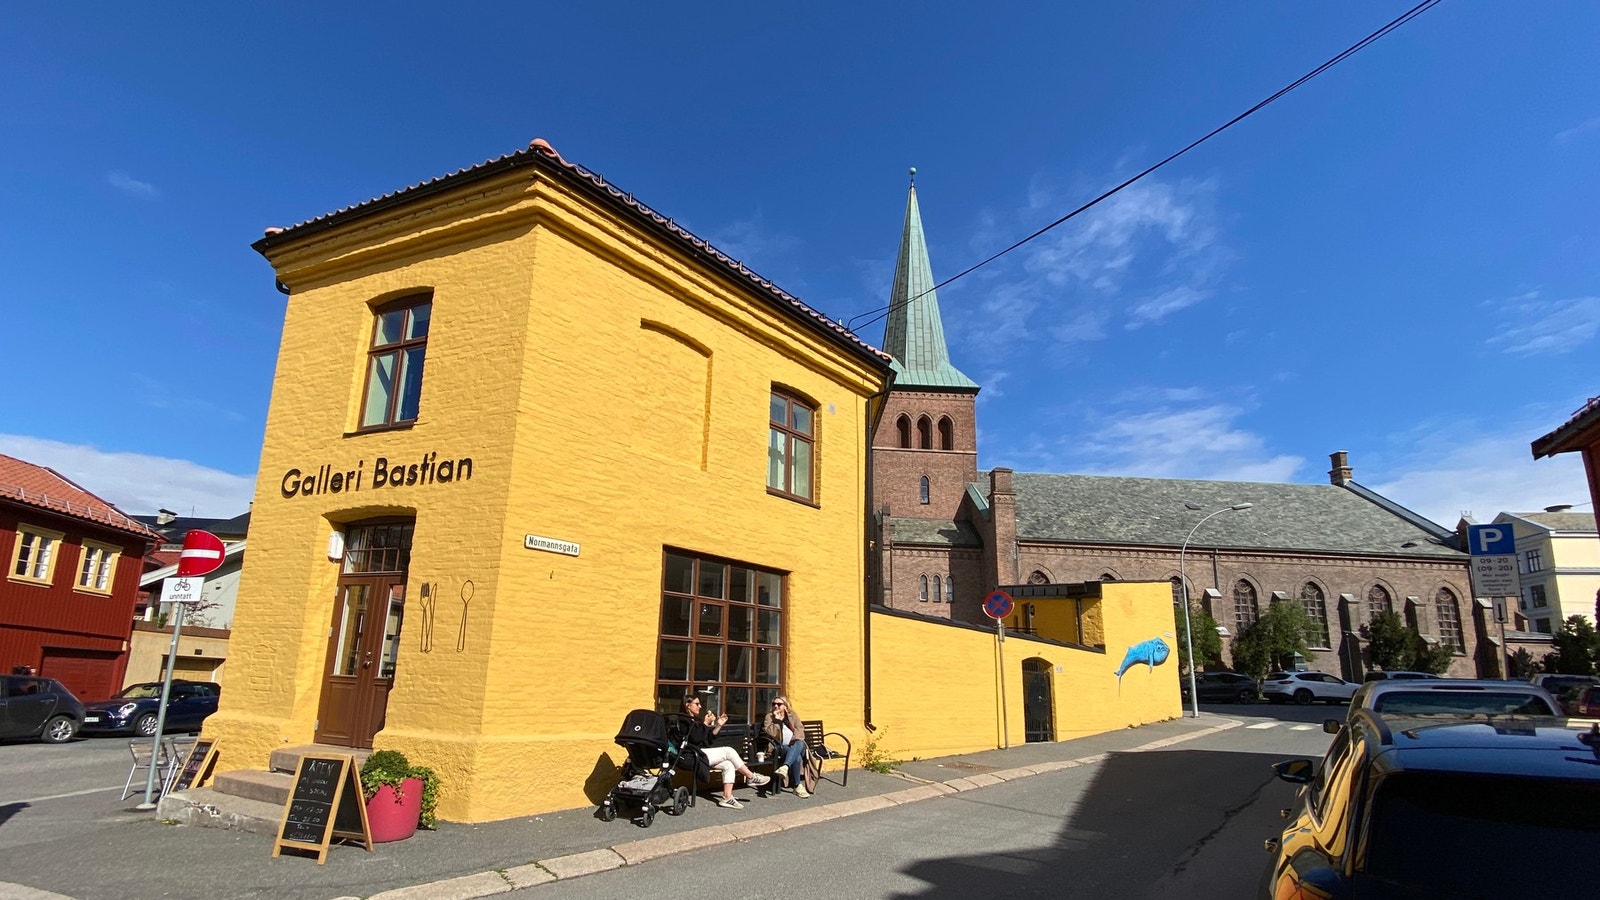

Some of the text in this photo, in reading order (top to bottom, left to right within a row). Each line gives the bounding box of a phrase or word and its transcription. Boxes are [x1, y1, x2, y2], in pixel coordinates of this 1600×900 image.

[281, 451, 473, 499] Galleri Bastian
[528, 536, 578, 553] Normannsgata
[1478, 527, 1503, 552] P
